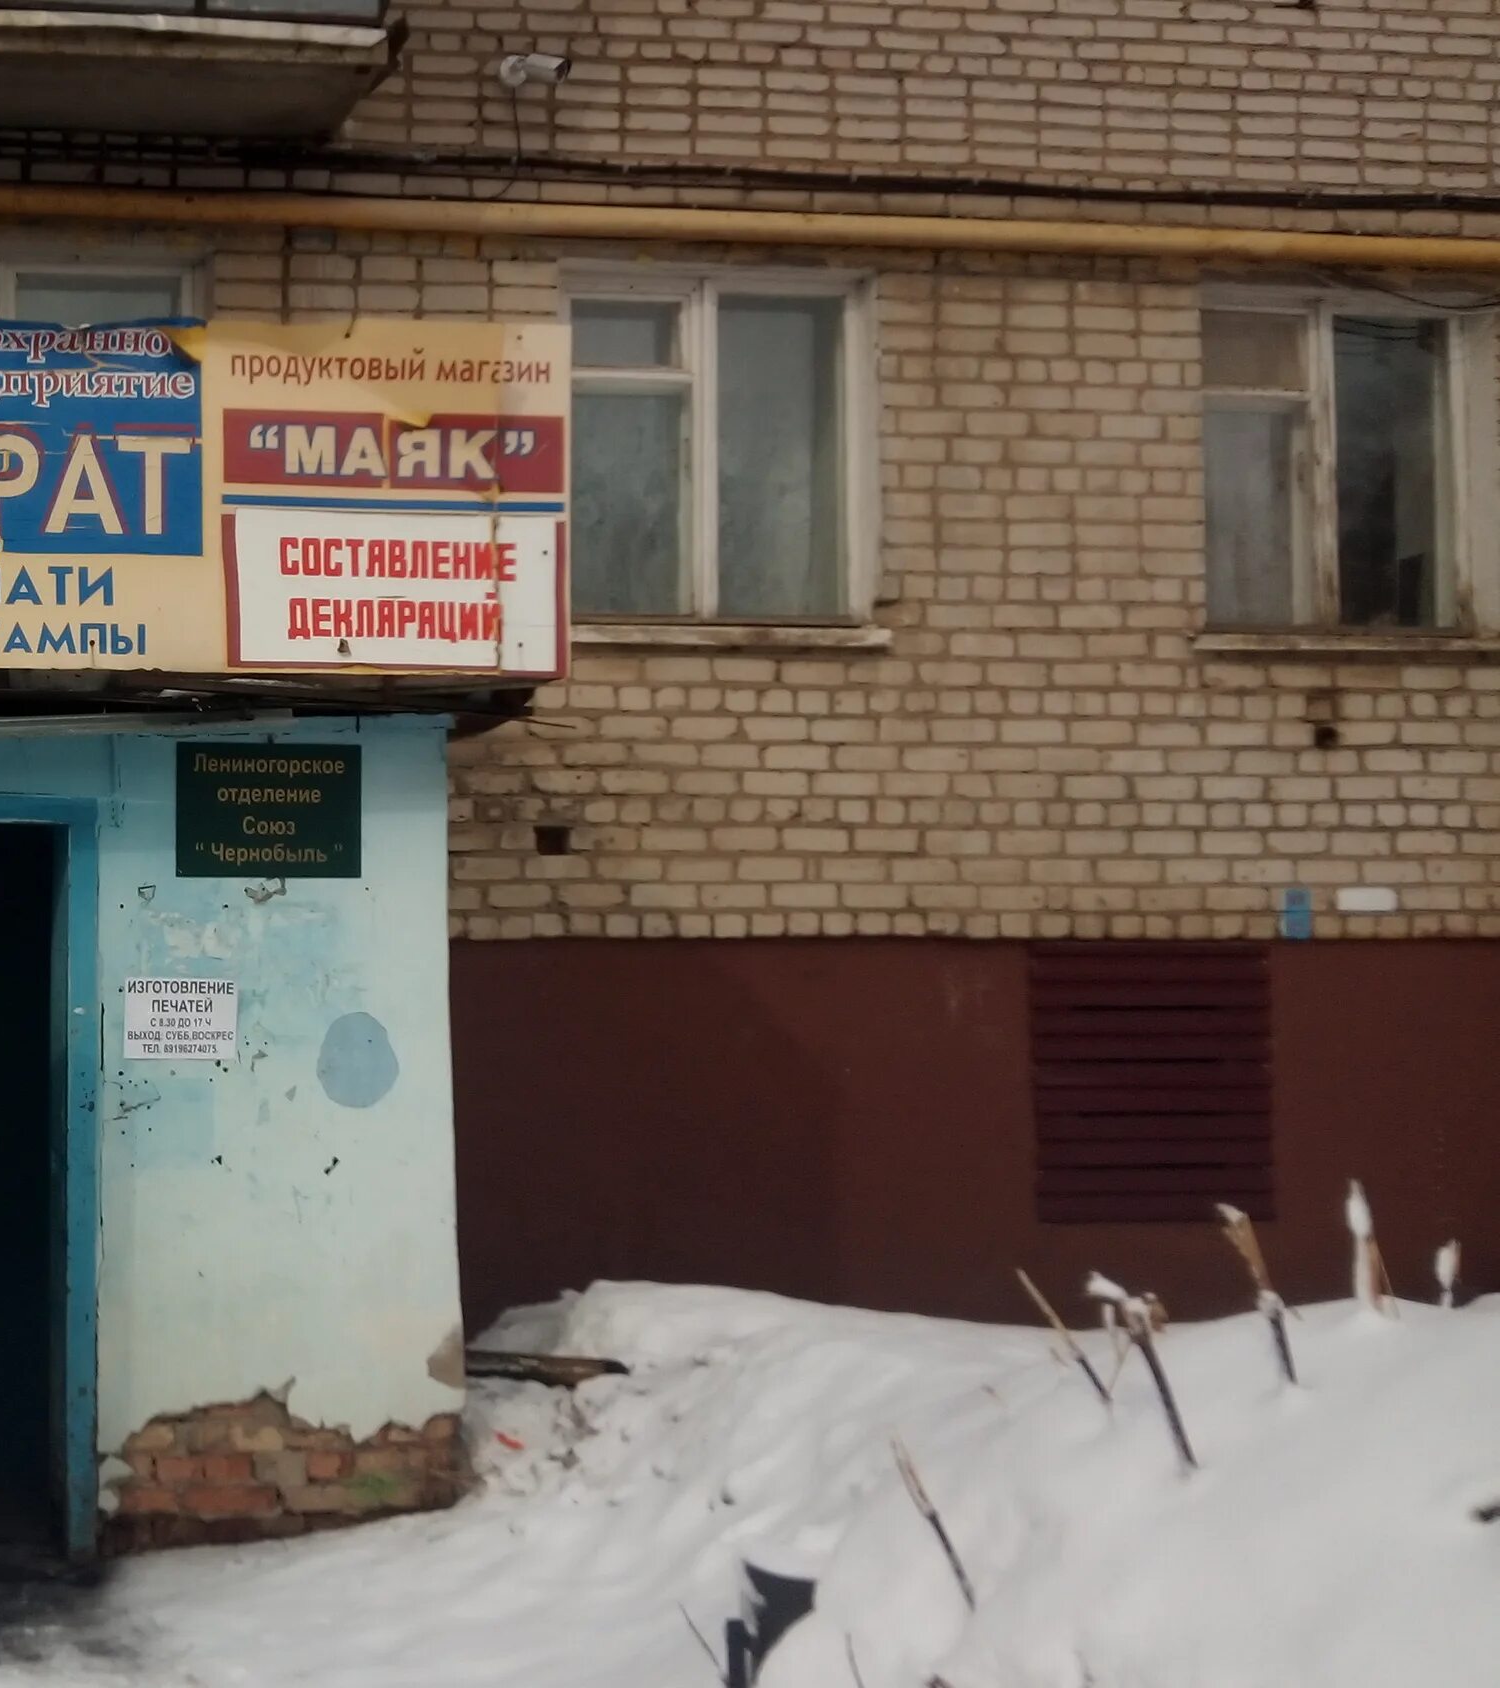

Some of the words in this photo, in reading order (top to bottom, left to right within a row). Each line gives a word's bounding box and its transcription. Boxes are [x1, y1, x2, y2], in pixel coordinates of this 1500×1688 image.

[231, 347, 425, 385] продуктовый
[436, 360, 551, 385] магазин
[279, 537, 517, 582] СОСТАВЛЕНИЕ
[287, 592, 503, 643] ДЕКЛАРАЦИЙ
[193, 753, 345, 777] Лениногорское
[217, 787, 322, 805] отделение
[242, 816, 296, 835] Союз
[127, 980, 235, 995] ИЗГОТОВЛЕНИЕ
[151, 997, 213, 1013] ПЕЧАТЕЙ
[150, 1018, 156, 1027] С
[177, 1018, 191, 1028] ДО
[194, 1018, 203, 1027] 17
